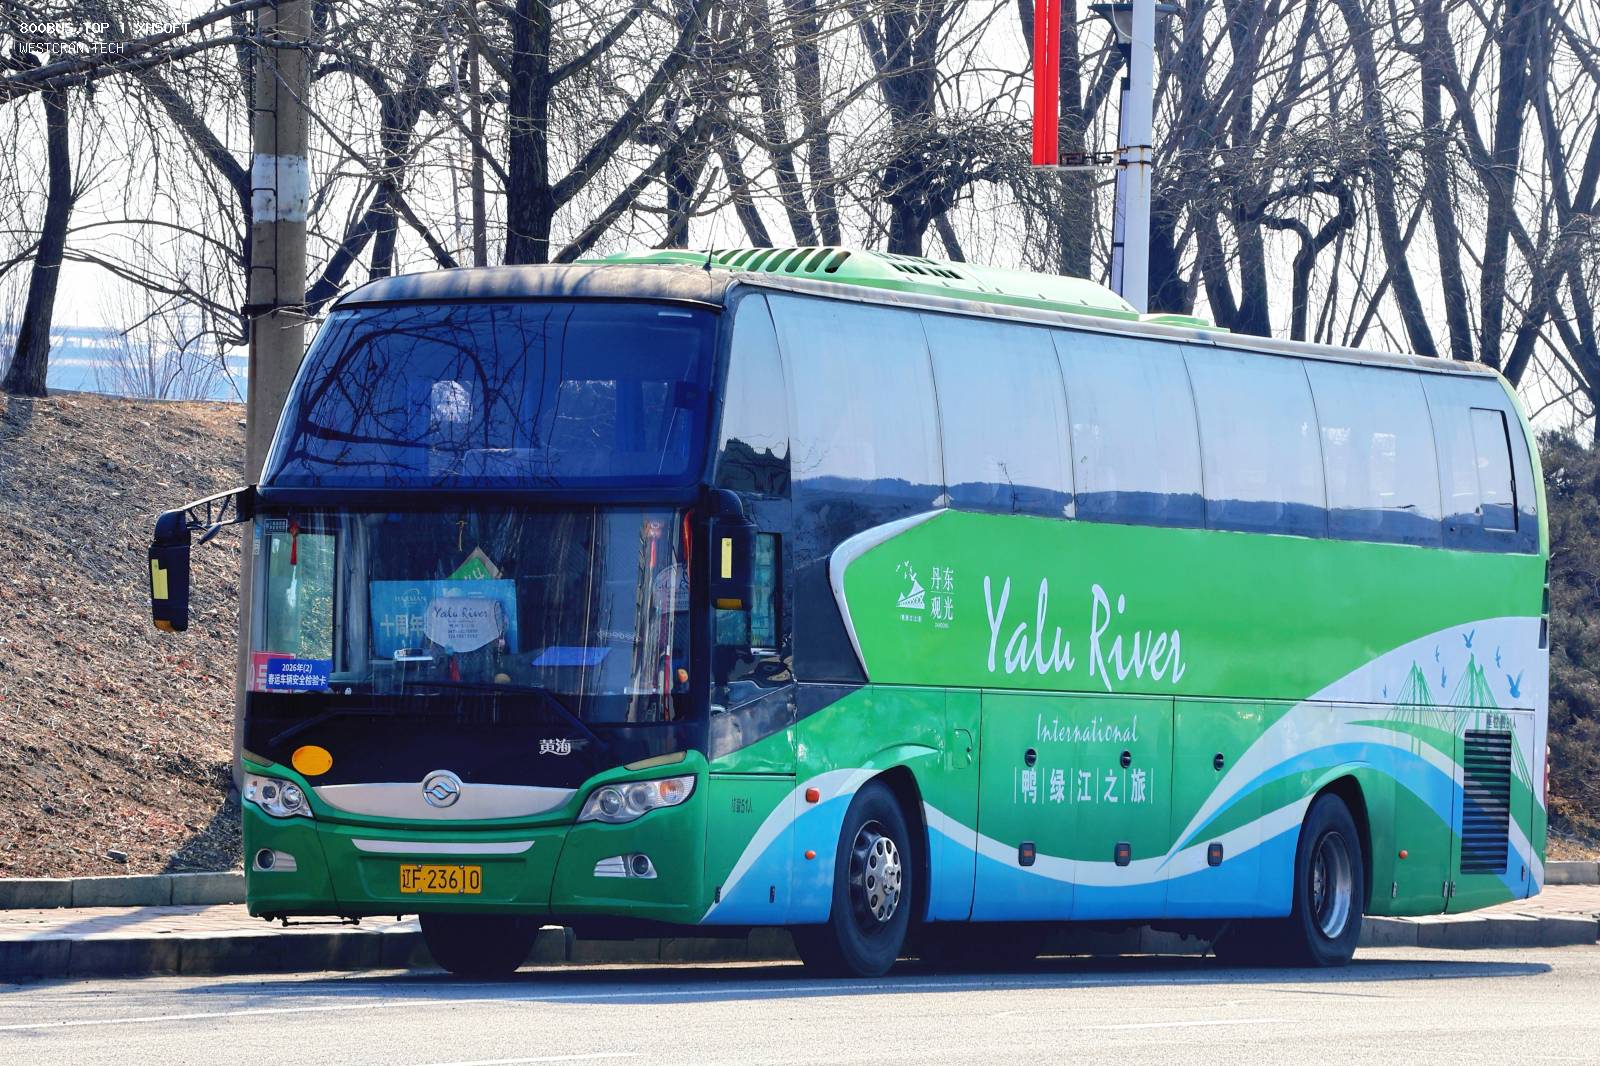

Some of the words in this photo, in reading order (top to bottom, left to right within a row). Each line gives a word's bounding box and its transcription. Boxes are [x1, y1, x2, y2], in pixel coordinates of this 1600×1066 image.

[930, 566, 954, 591] 丹东
[434, 607, 458, 618] Yalu
[462, 607, 488, 619] River
[930, 596, 954, 621] 观光
[983, 575, 1075, 675] Yalu
[1089, 583, 1186, 692] River
[1037, 712, 1140, 743] International
[538, 738, 572, 756] 黄海
[1020, 767, 1147, 804] 鸭绿江之旅
